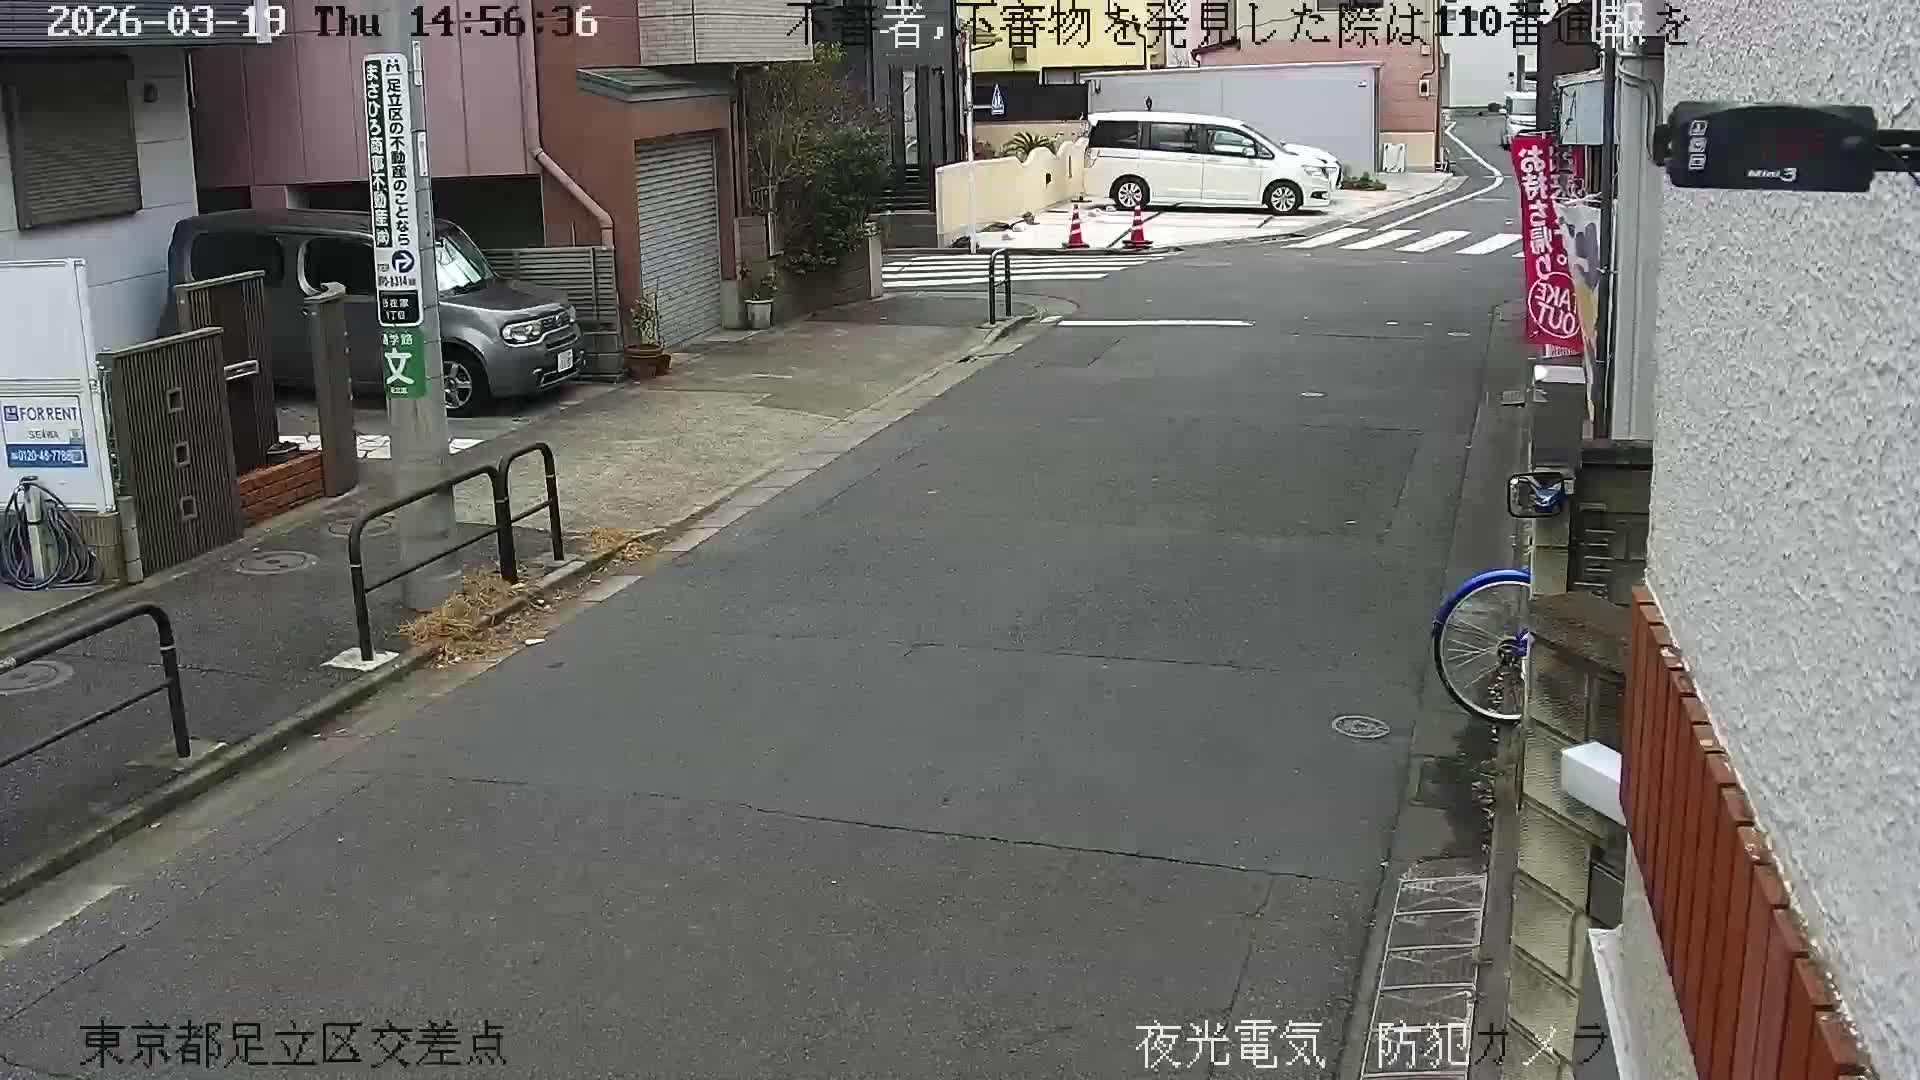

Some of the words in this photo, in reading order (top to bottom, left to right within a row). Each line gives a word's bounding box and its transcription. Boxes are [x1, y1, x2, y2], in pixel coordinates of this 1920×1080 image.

[387, 78, 410, 246] 足立区の不動産のことなら
[384, 347, 415, 385] 文
[19, 406, 45, 421] FOR
[46, 406, 78, 421] RENT
